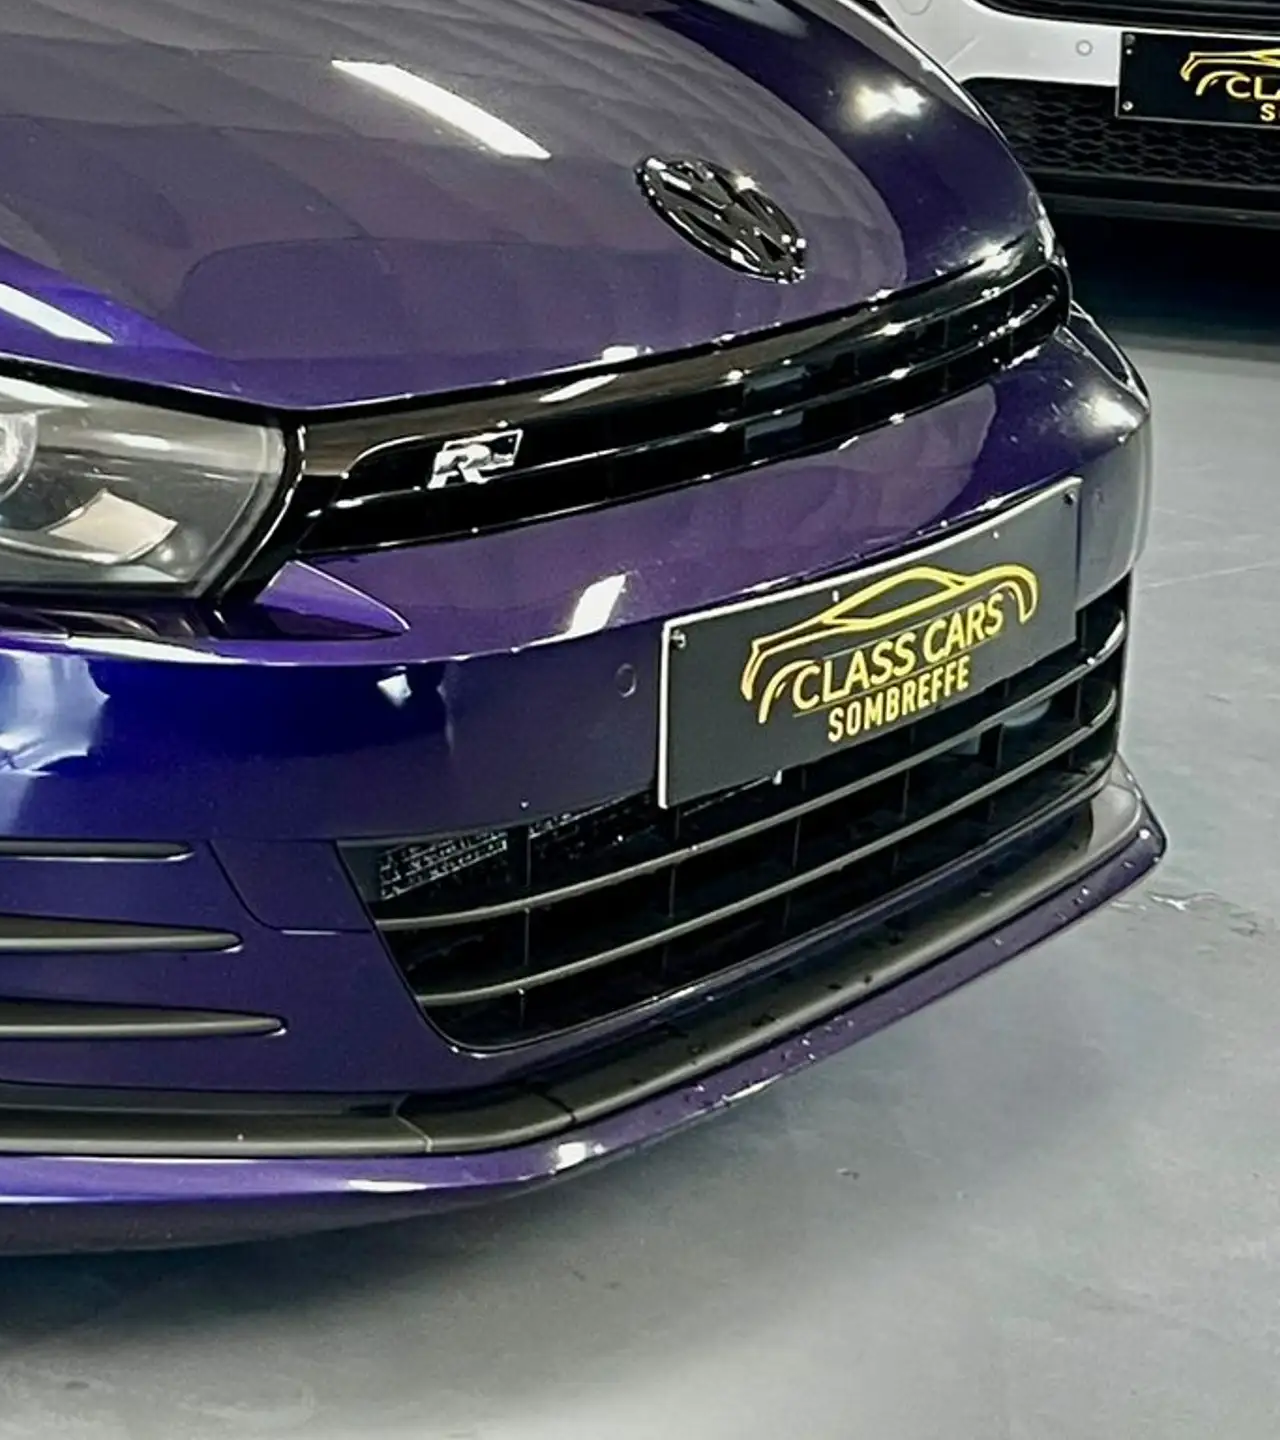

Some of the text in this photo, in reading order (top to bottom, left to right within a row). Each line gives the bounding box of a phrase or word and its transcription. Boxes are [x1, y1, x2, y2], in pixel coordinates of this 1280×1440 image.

[792, 592, 1005, 710] CLASS CARS
[827, 655, 971, 743] SOMBREFFE
